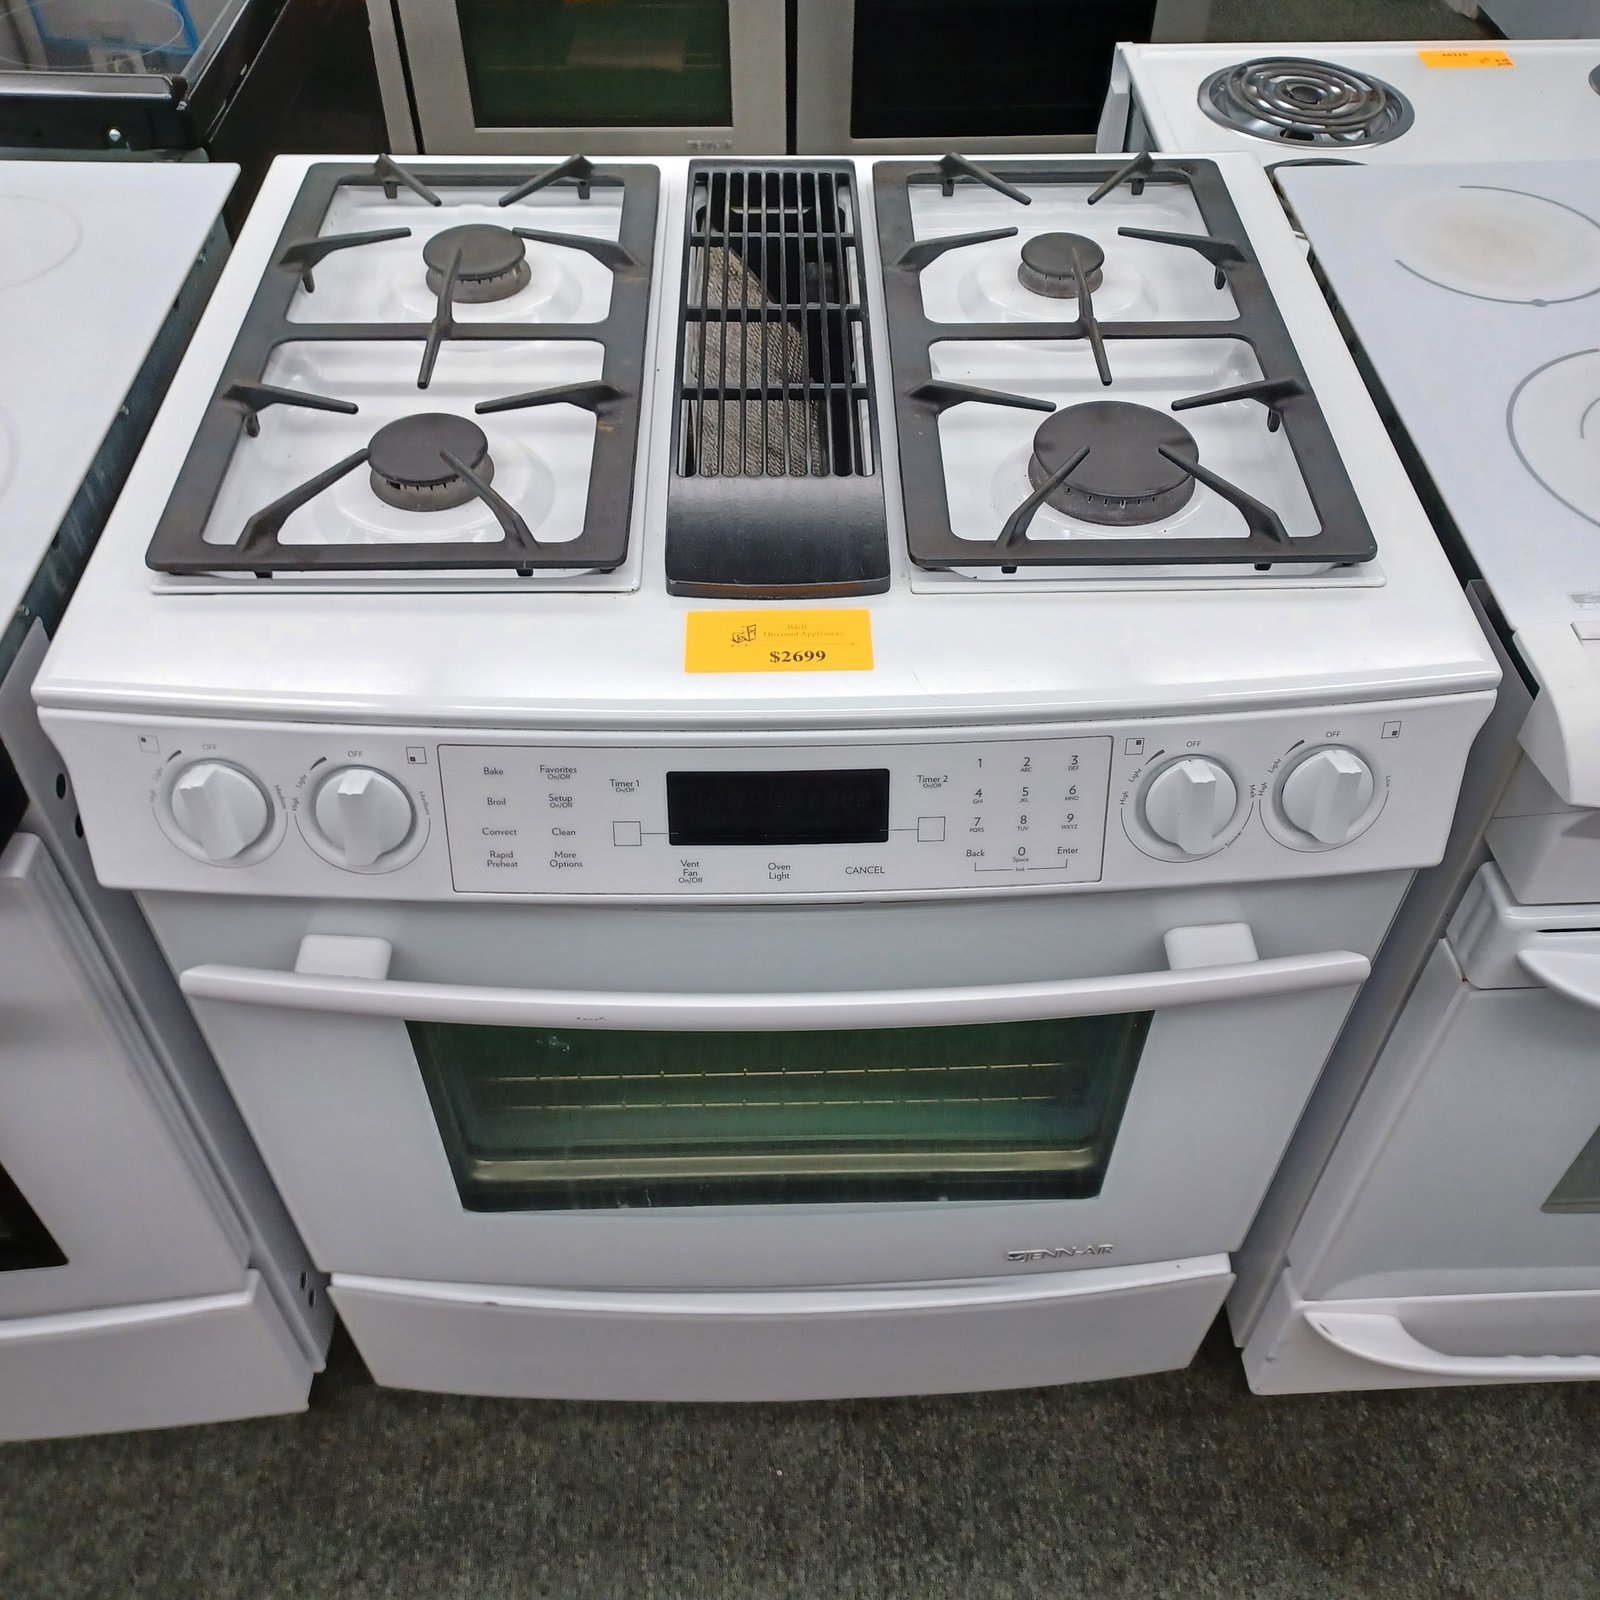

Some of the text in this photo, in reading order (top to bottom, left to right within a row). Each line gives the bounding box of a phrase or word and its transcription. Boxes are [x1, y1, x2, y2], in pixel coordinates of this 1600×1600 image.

[769, 650, 826, 663] $2699
[1325, 730, 1341, 738] OFF
[1186, 740, 1202, 748] OFF
[978, 758, 983, 768] 1
[1024, 757, 1031, 767] 2
[1072, 755, 1079, 765] 3
[483, 766, 504, 776] Bake
[539, 764, 578, 774] Favorites
[1267, 758, 1282, 774] Light
[917, 775, 949, 783] Timer 2
[1128, 767, 1143, 783] Light
[609, 778, 640, 788] Timer 1
[975, 788, 983, 798] 4
[1022, 787, 1029, 797] 5
[1069, 785, 1077, 795] 6
[1258, 781, 1268, 797] High
[487, 797, 506, 806] Broil
[549, 793, 573, 803] Setup
[1119, 790, 1129, 806] High
[974, 817, 981, 827] 7
[1020, 815, 1027, 825] 8
[1066, 813, 1074, 823] 9
[482, 827, 517, 837] Convect
[551, 827, 576, 836] Clean
[554, 851, 577, 859] More
[966, 849, 985, 857] Back
[1057, 846, 1079, 854] Enter
[489, 851, 514, 860] Rapid
[487, 860, 518, 868] Preheat
[549, 859, 583, 869] Options
[680, 860, 700, 868] Vent
[768, 862, 791, 871] Oven
[682, 869, 698, 877] Fan
[845, 865, 885, 875] CANCEL
[678, 876, 703, 884] On/Off
[768, 871, 790, 882] Light
